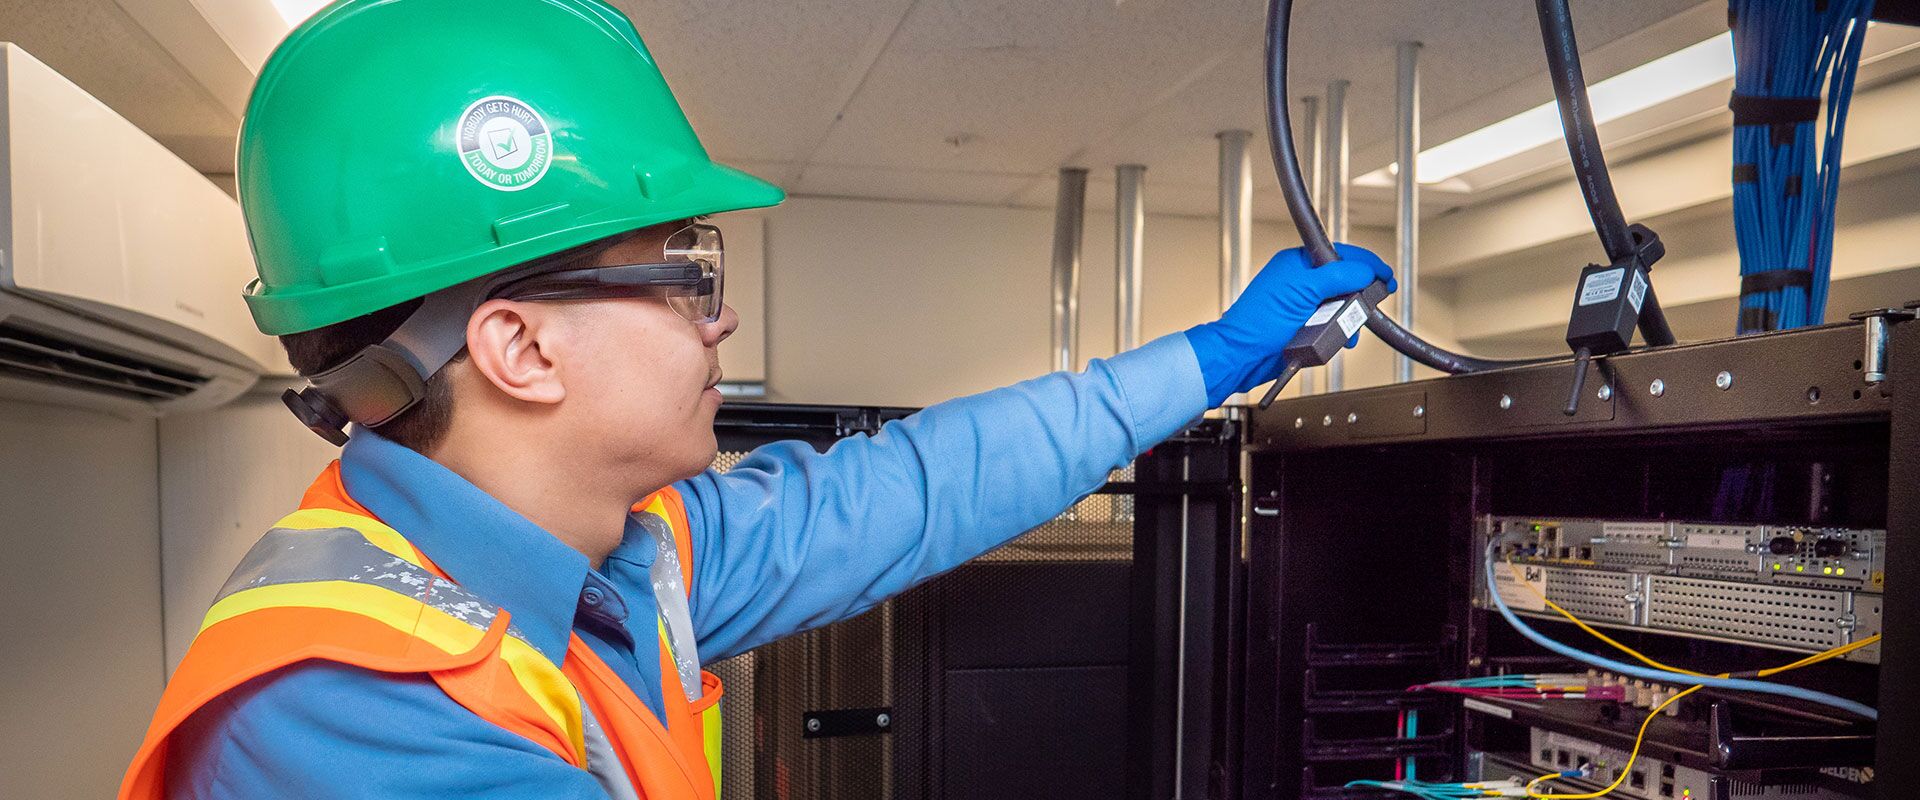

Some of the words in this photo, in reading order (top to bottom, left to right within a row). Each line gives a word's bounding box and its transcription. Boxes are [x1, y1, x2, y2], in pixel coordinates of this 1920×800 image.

[463, 107, 487, 141] NOBODY
[486, 102, 510, 114] GETS
[511, 105, 535, 124] HURT
[469, 153, 497, 180] TODAY
[498, 173, 512, 185] OR
[513, 138, 546, 184] TOMORROW
[1525, 566, 1542, 582] Bell
